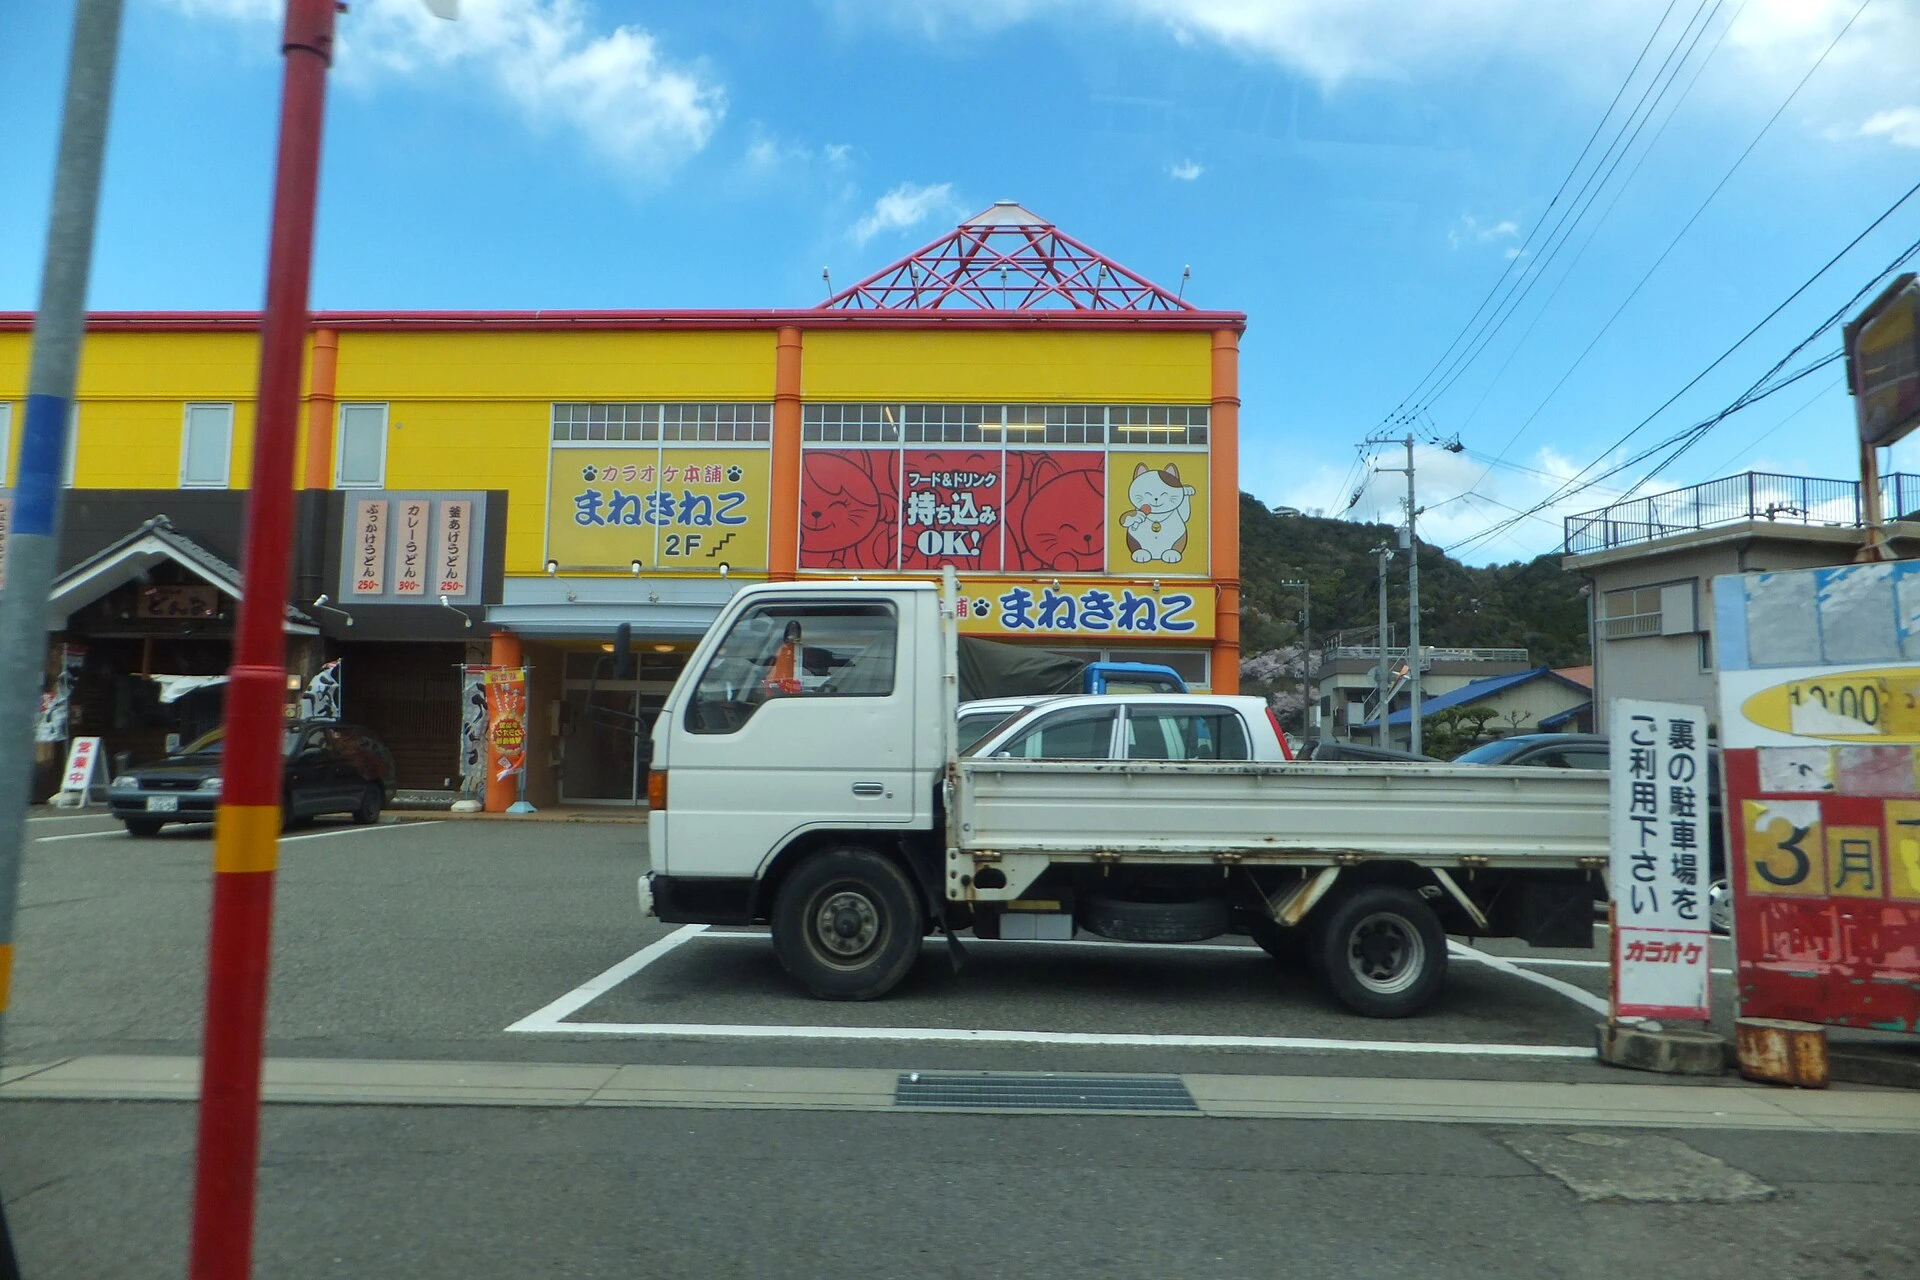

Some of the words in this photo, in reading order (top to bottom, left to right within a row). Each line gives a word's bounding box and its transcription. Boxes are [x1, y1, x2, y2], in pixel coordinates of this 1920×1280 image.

[602, 465, 722, 483] カラオケ本舗
[908, 472, 997, 488] フード&ドリンク
[574, 489, 747, 526] まねきねこ
[907, 491, 997, 526] 持ち込み
[363, 504, 379, 578] ぶっかけうどん
[404, 505, 421, 578] カレーうどん
[445, 505, 462, 579] 釜あげうどん
[665, 534, 701, 556] 2F
[917, 530, 981, 556] OK!
[1000, 588, 1196, 631] まねきねこ
[1629, 714, 1659, 914] ご利用下さい
[1668, 718, 1699, 920] 裏の駐車場を
[1624, 940, 1703, 965] カラオケ
